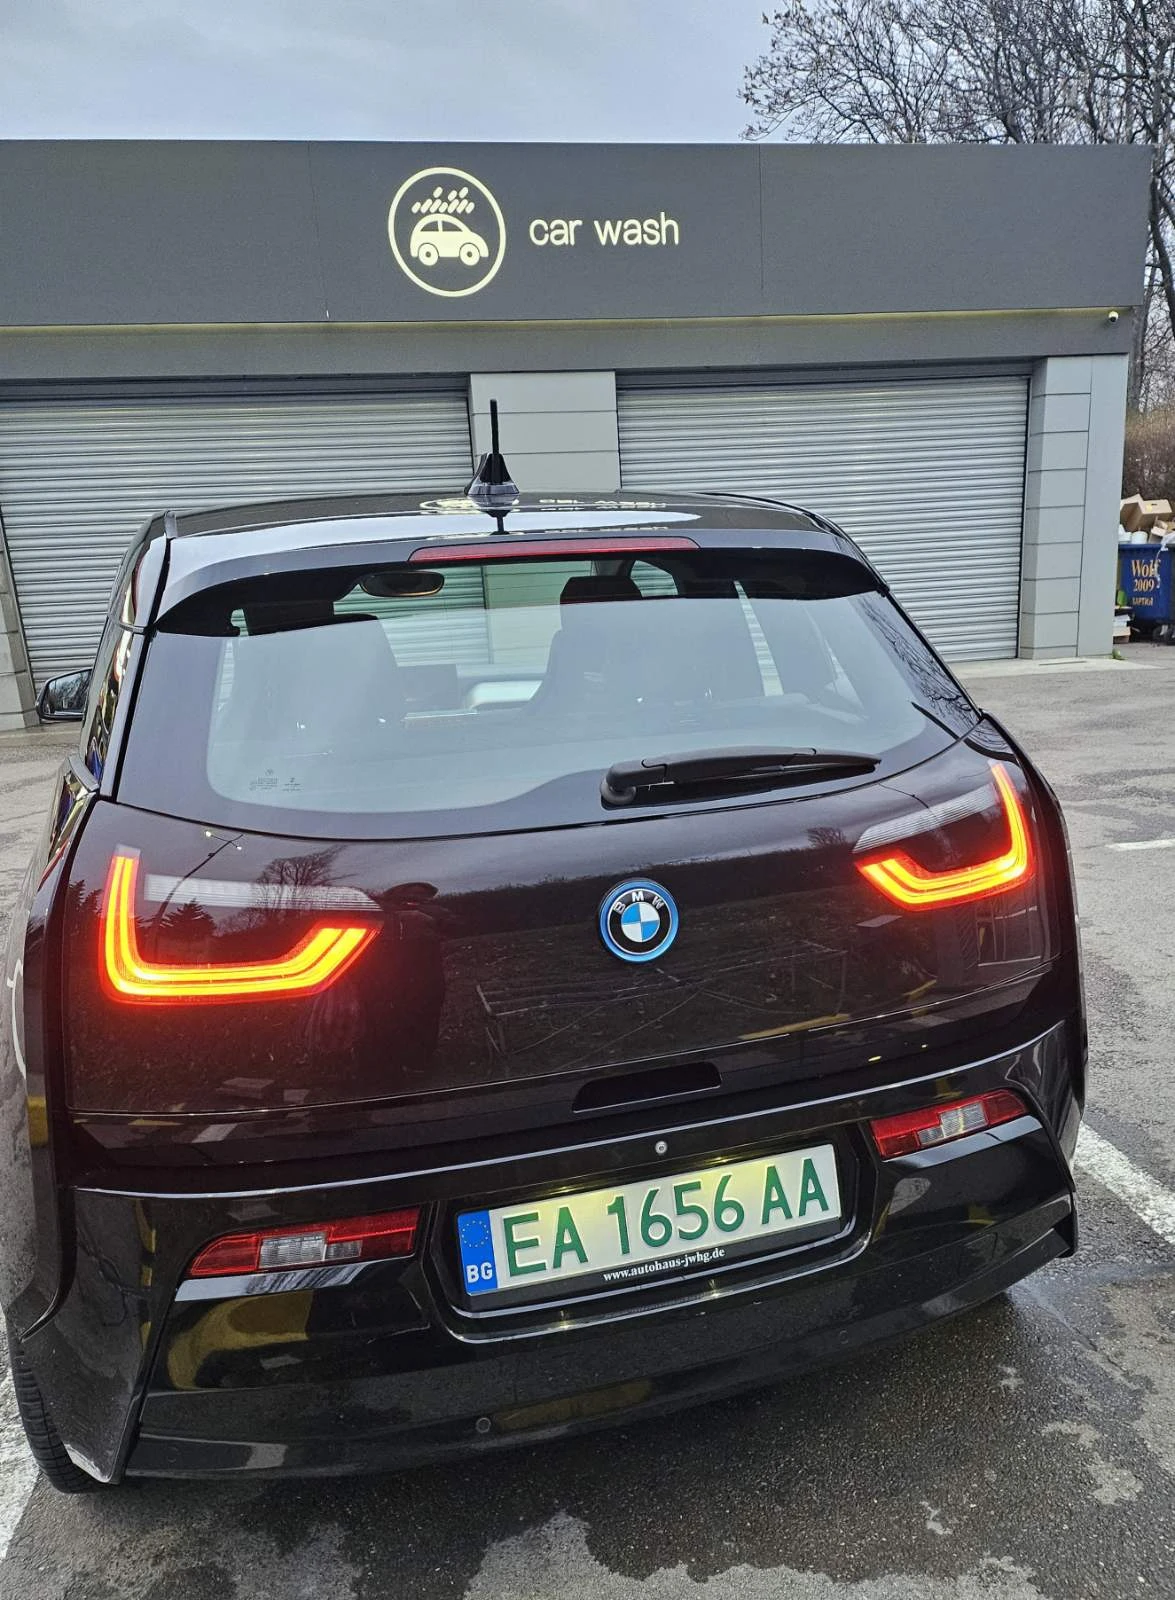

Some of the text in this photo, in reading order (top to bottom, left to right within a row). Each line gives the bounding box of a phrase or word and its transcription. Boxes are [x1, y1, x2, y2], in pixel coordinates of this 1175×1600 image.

[529, 211, 680, 246] car wash
[1131, 559, 1161, 578] Wolf
[1133, 578, 1155, 592] 2009
[613, 890, 665, 914] BMW
[503, 1158, 830, 1277] EA 1656 AA
[466, 1261, 493, 1284] BG
[603, 1247, 726, 1282] www.autohaus-jwhg.de
